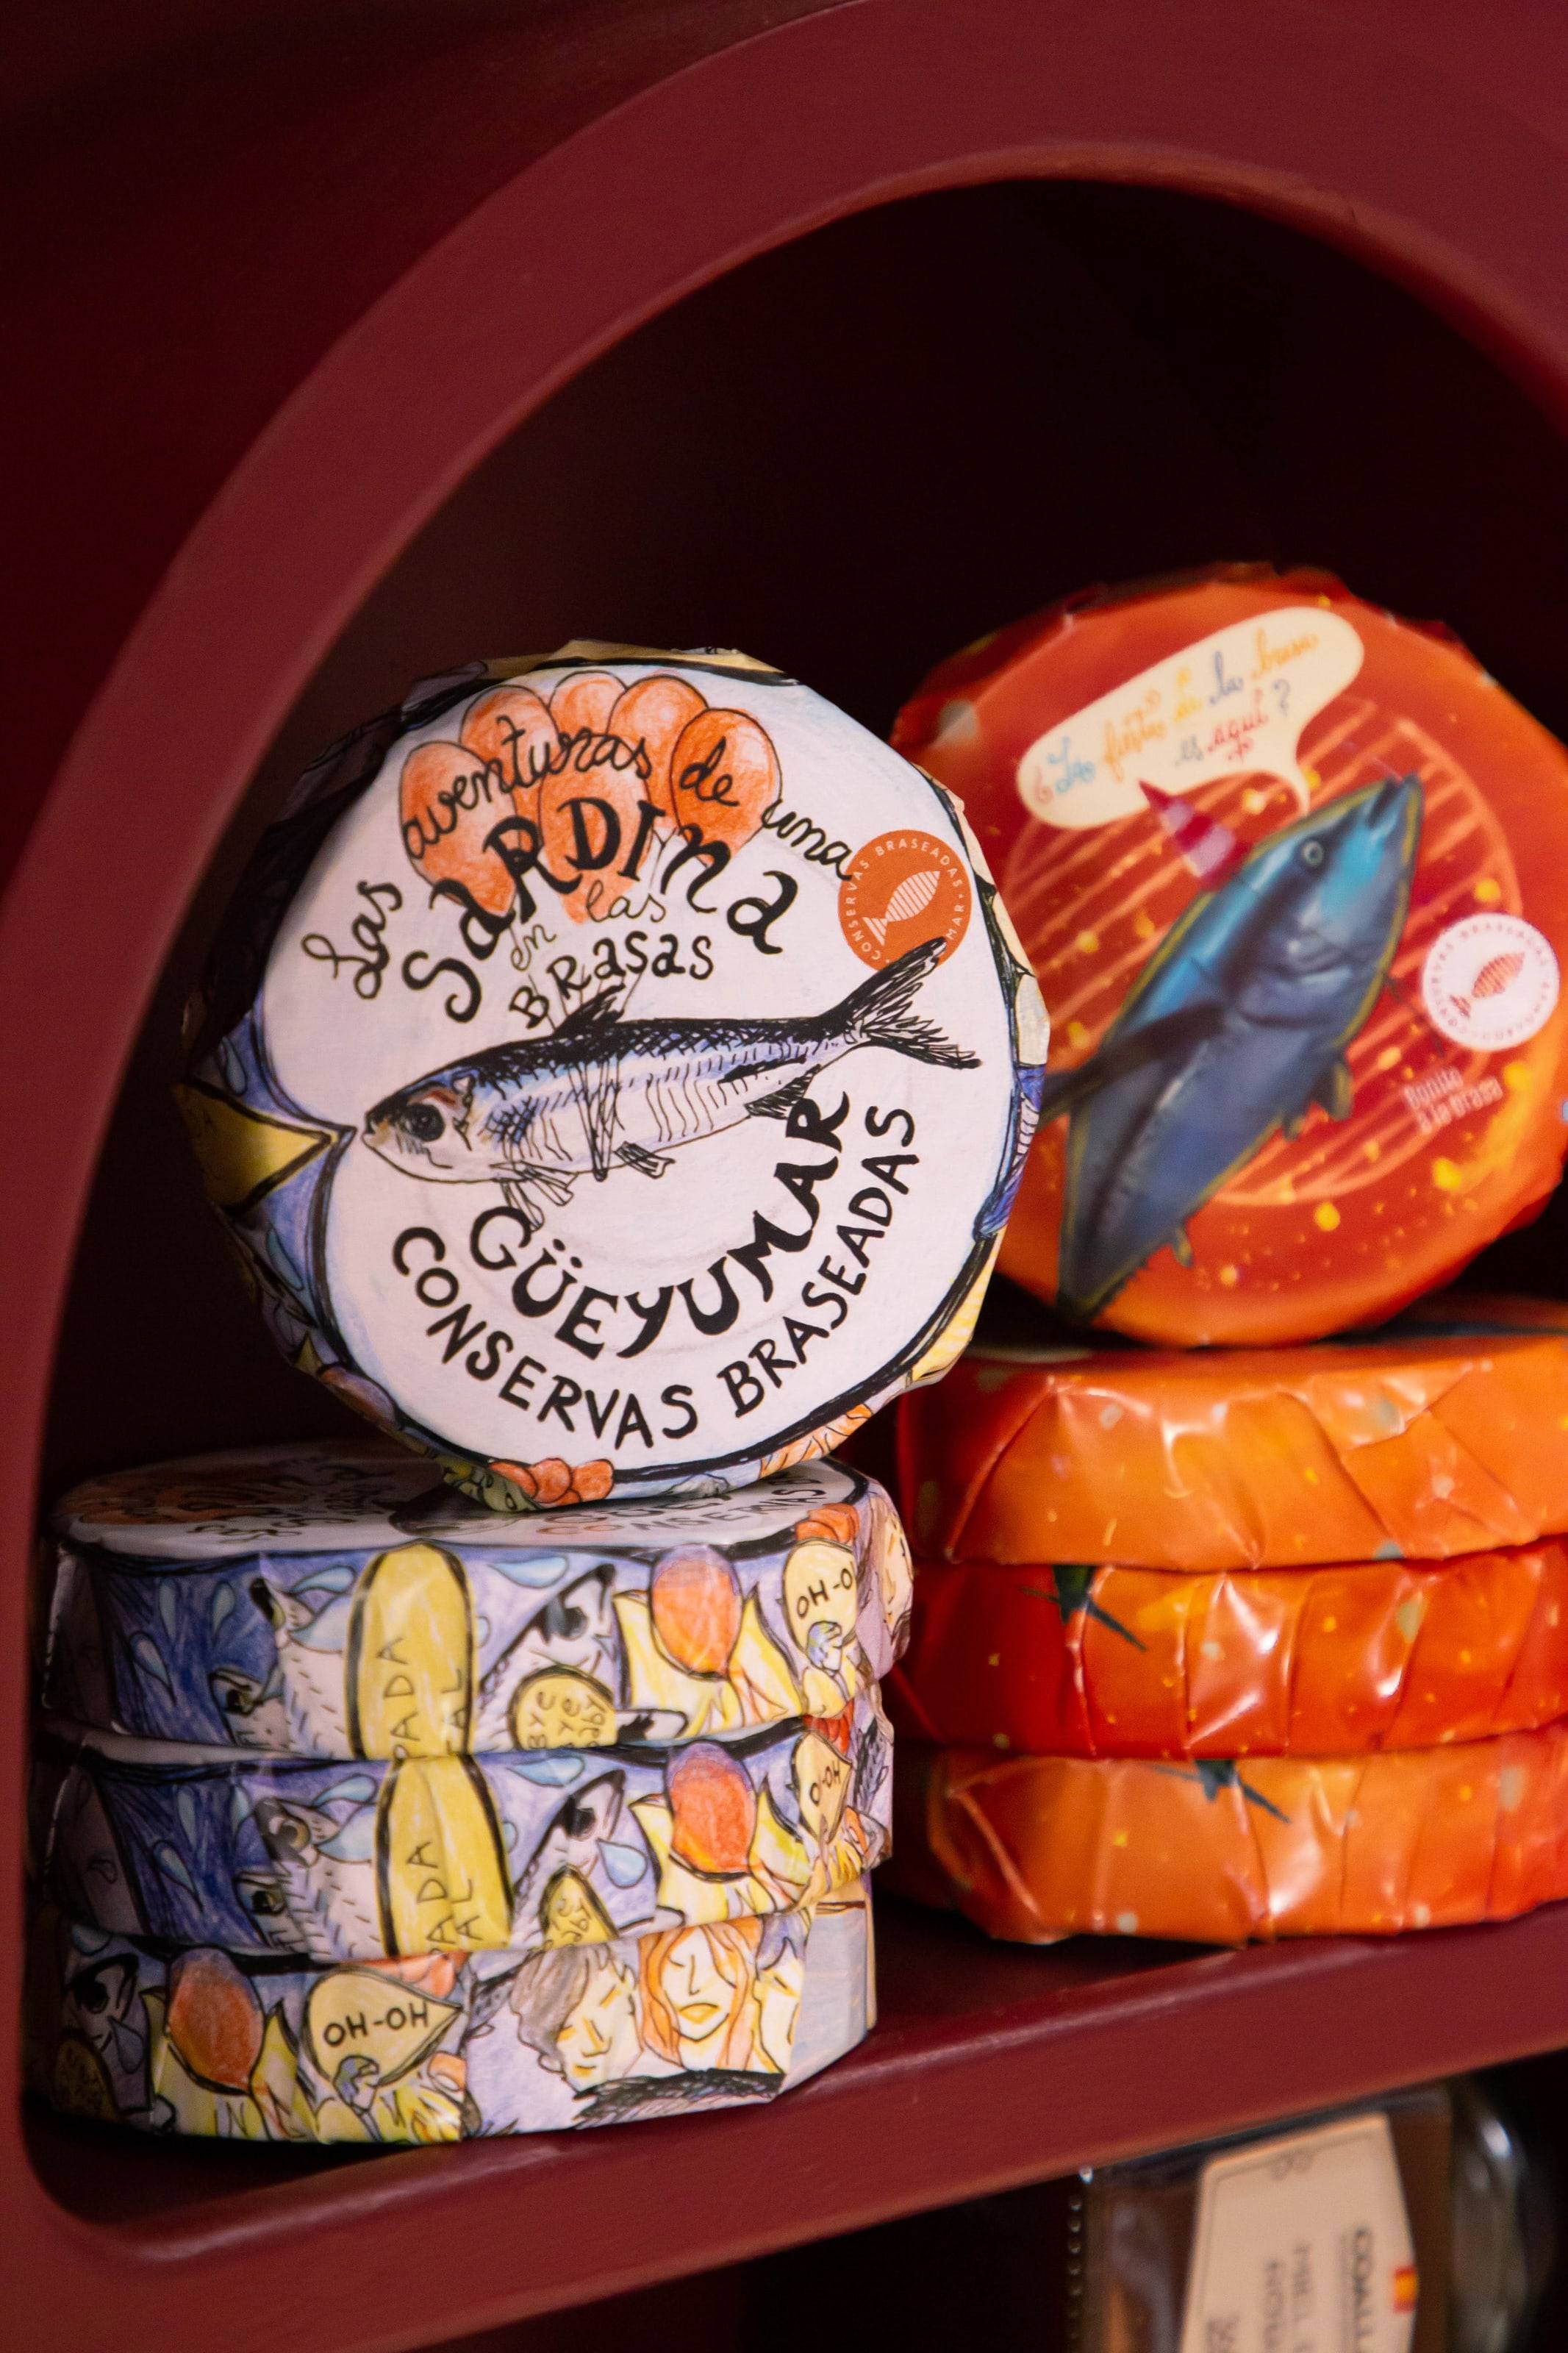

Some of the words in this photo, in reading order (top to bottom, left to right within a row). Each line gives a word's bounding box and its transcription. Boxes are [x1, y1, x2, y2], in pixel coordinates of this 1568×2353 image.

[303, 878, 403, 1000] Las
[403, 715, 652, 860] aventuras
[677, 735, 740, 807] de
[761, 799, 853, 881] una
[845, 860, 881, 960] CONSERVAS
[876, 838, 964, 887] BRASEADAS
[509, 922, 557, 971] en
[586, 879, 667, 924] las
[946, 904, 964, 940] MAR
[392, 1226, 699, 1449] CONSERVAS
[717, 1105, 920, 1418] BRASEADAS
[469, 1090, 849, 1360] GÜEYUMAR
[323, 2000, 429, 2047] OH-OH
